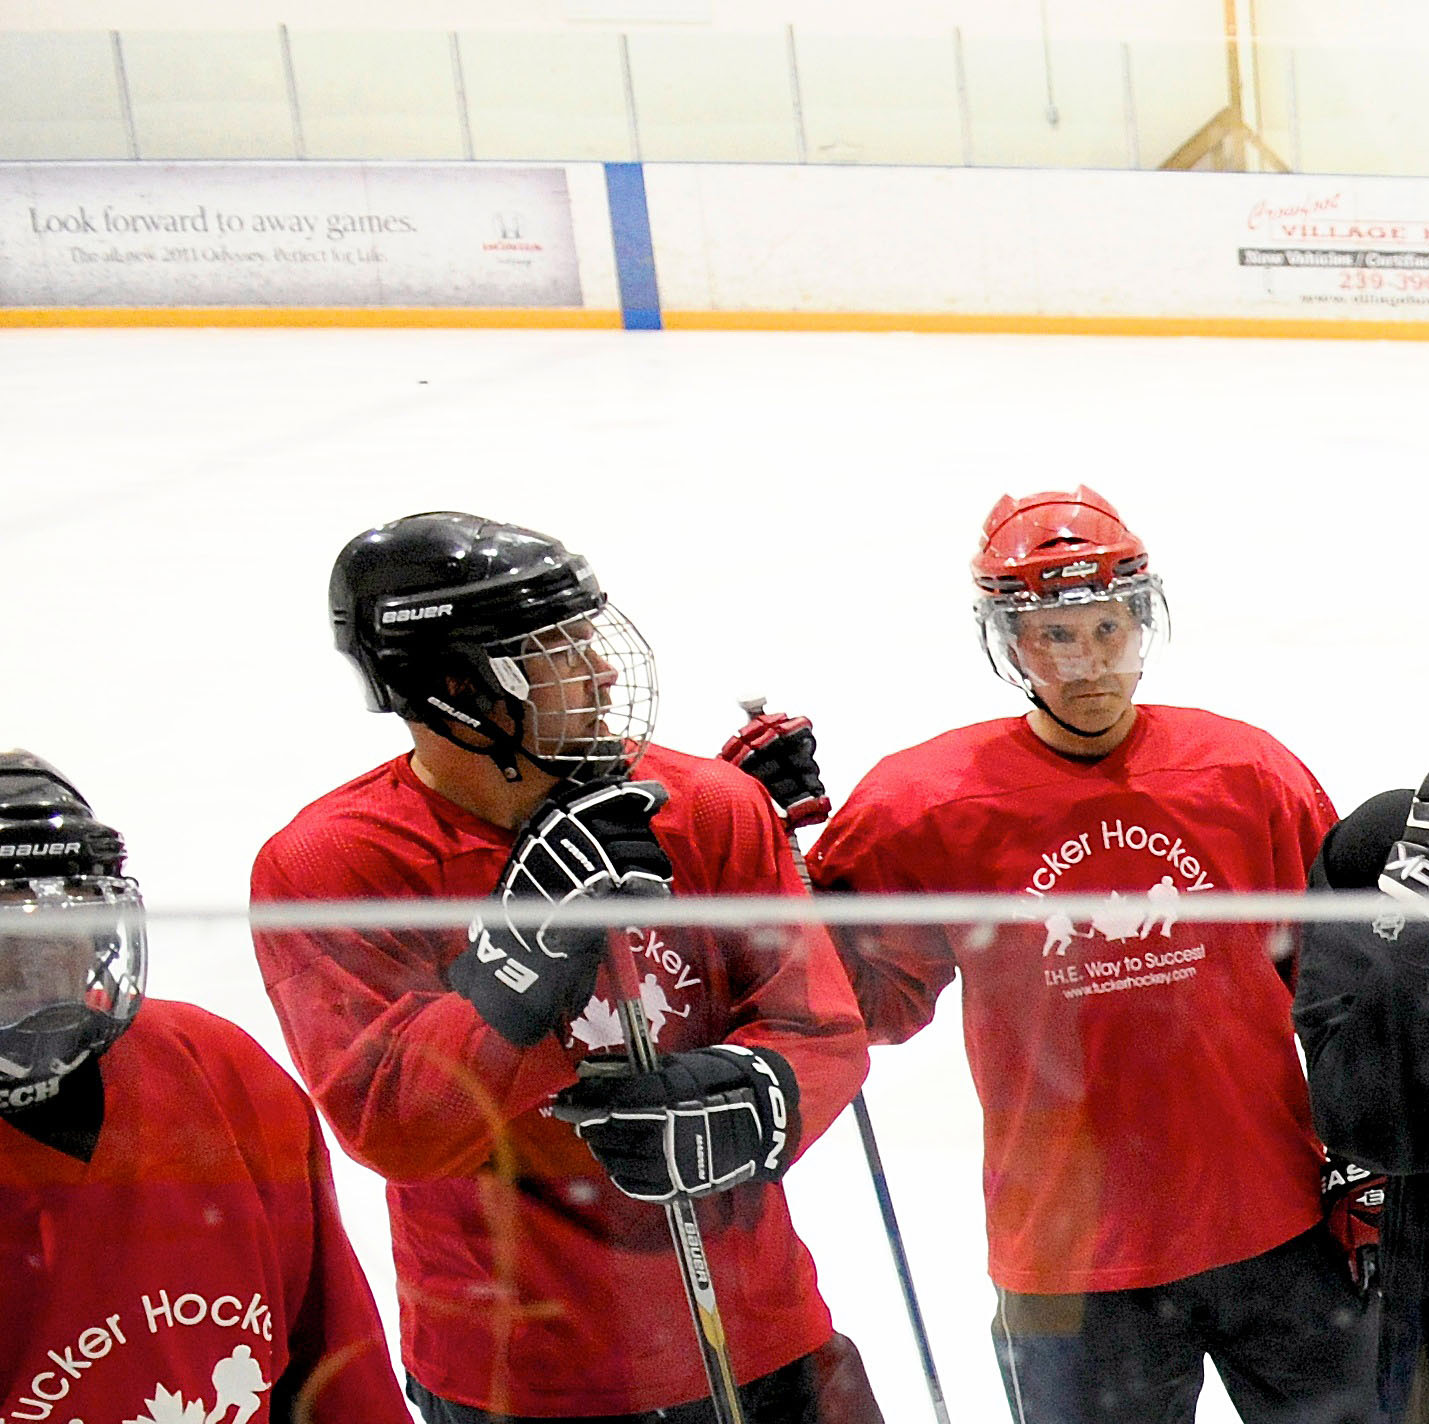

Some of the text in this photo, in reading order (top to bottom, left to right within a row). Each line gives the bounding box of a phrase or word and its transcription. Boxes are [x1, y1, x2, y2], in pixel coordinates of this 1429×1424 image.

[29, 204, 418, 240] Look forward to away games.
[1280, 223, 1407, 239] VILLAGE
[382, 603, 454, 624] BAUER
[1101, 820, 1214, 894] Hockey
[1085, 958, 1121, 981] Way
[1122, 956, 1142, 972] to
[1144, 943, 1206, 969] Success!
